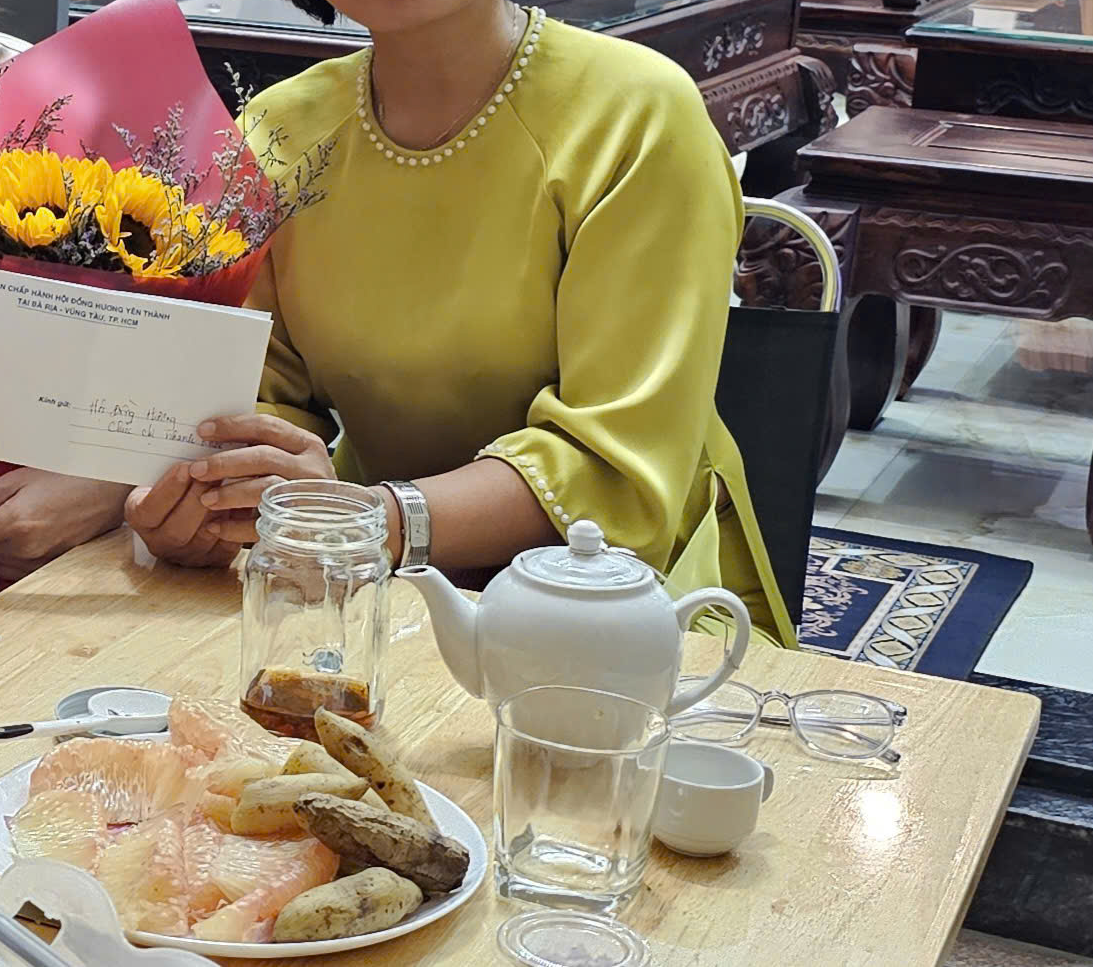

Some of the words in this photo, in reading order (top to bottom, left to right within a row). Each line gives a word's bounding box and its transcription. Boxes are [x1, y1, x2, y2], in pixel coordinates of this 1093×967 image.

[8, 284, 29, 295] CHẤP
[31, 289, 53, 300] HÀNH
[55, 294, 69, 304] HỘI
[126, 306, 142, 316] YÊN
[144, 309, 171, 320] THÀNH
[32, 300, 42, 309] BÀ
[120, 317, 139, 326] HCM
